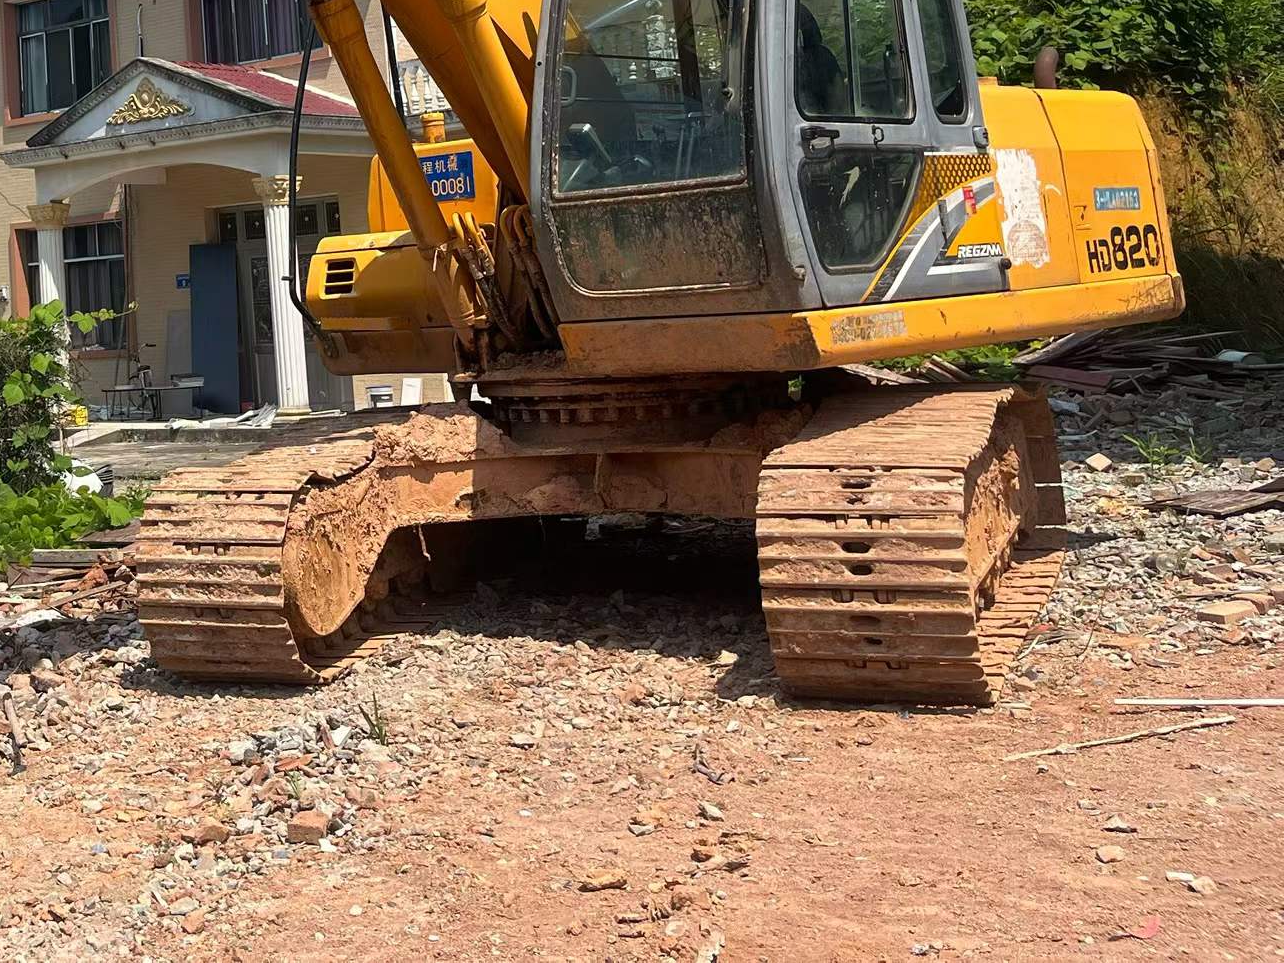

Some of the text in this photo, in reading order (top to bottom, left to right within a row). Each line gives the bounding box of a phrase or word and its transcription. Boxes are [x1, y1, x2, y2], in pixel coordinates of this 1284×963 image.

[422, 154, 458, 175] 程机械
[1085, 223, 1161, 274] HD820
